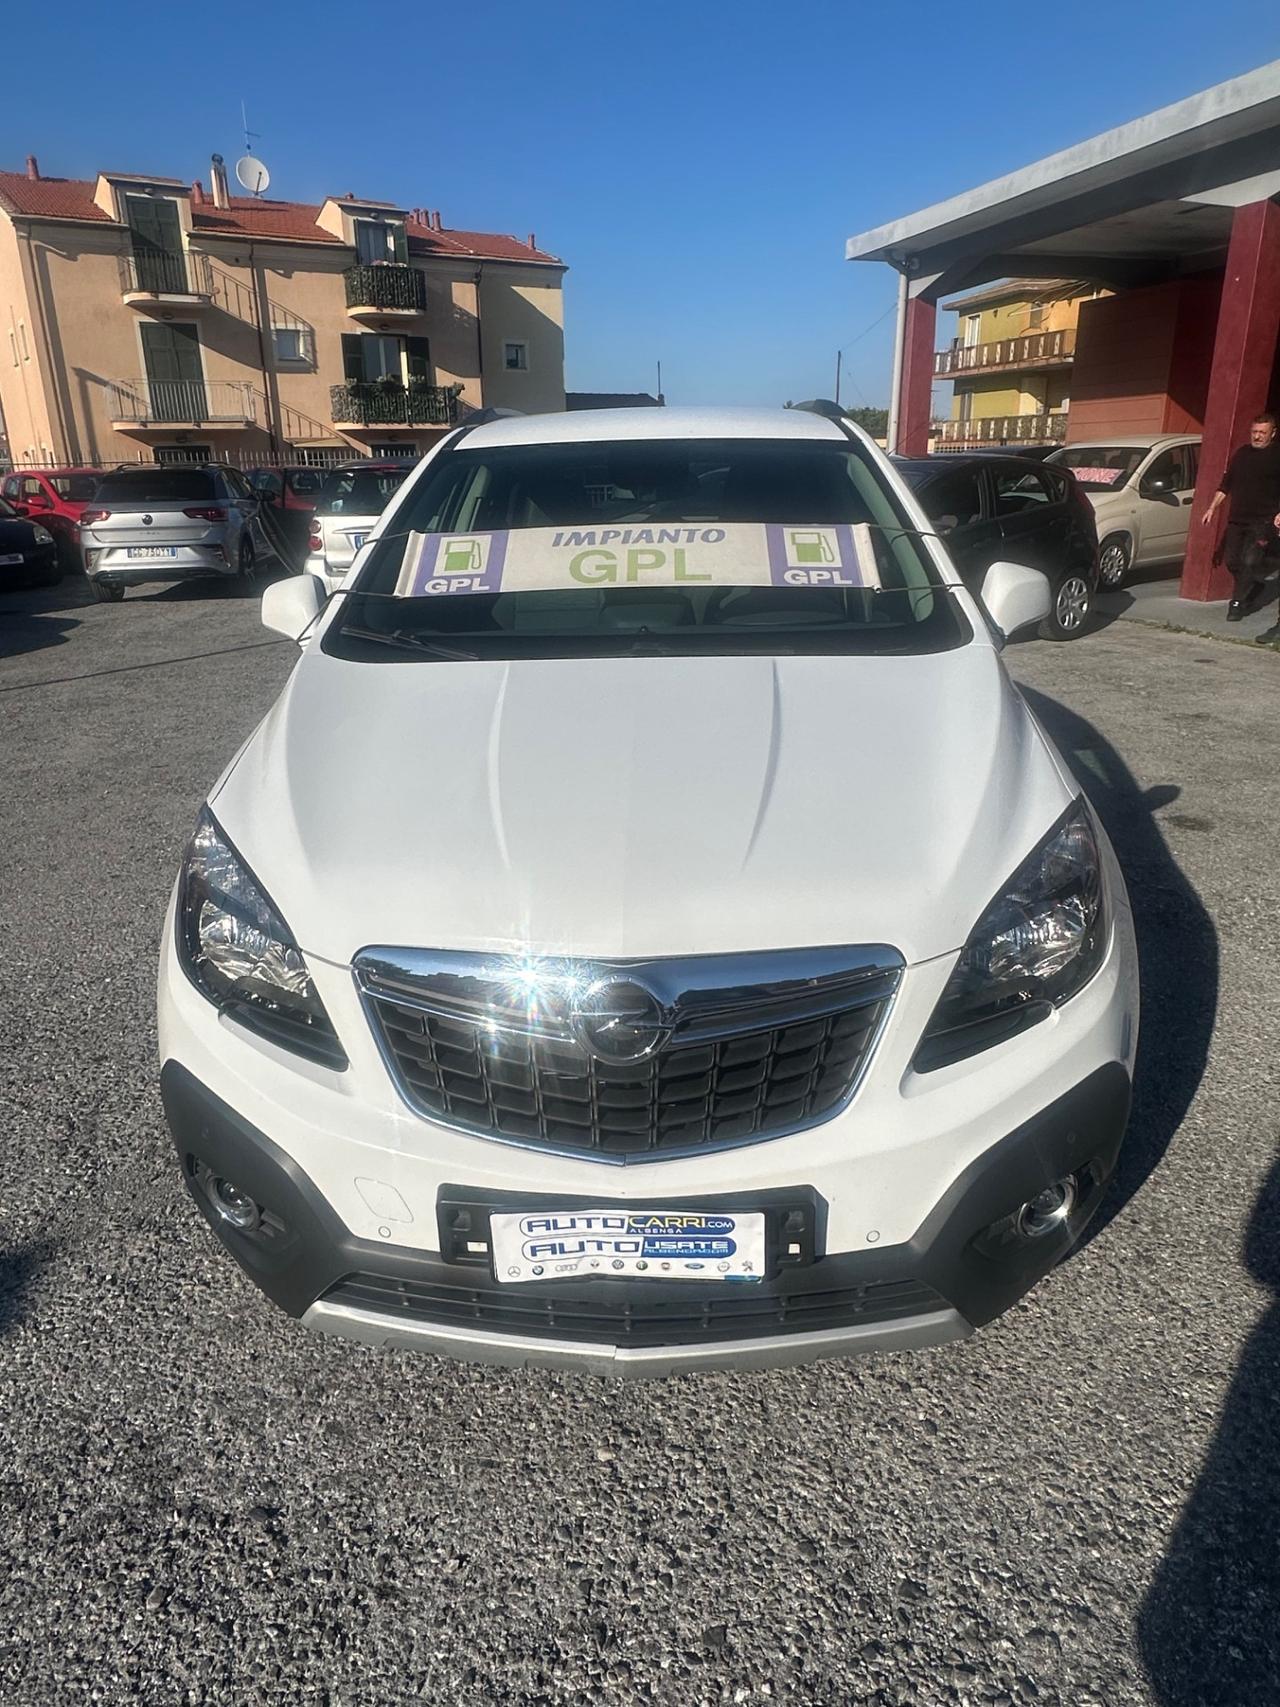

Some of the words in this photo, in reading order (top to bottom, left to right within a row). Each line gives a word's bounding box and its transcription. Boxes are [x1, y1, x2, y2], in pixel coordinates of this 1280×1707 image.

[551, 527, 726, 547] IMPIANTO
[569, 548, 712, 584] GPL
[424, 577, 490, 594] GPL
[784, 569, 852, 585] GPL
